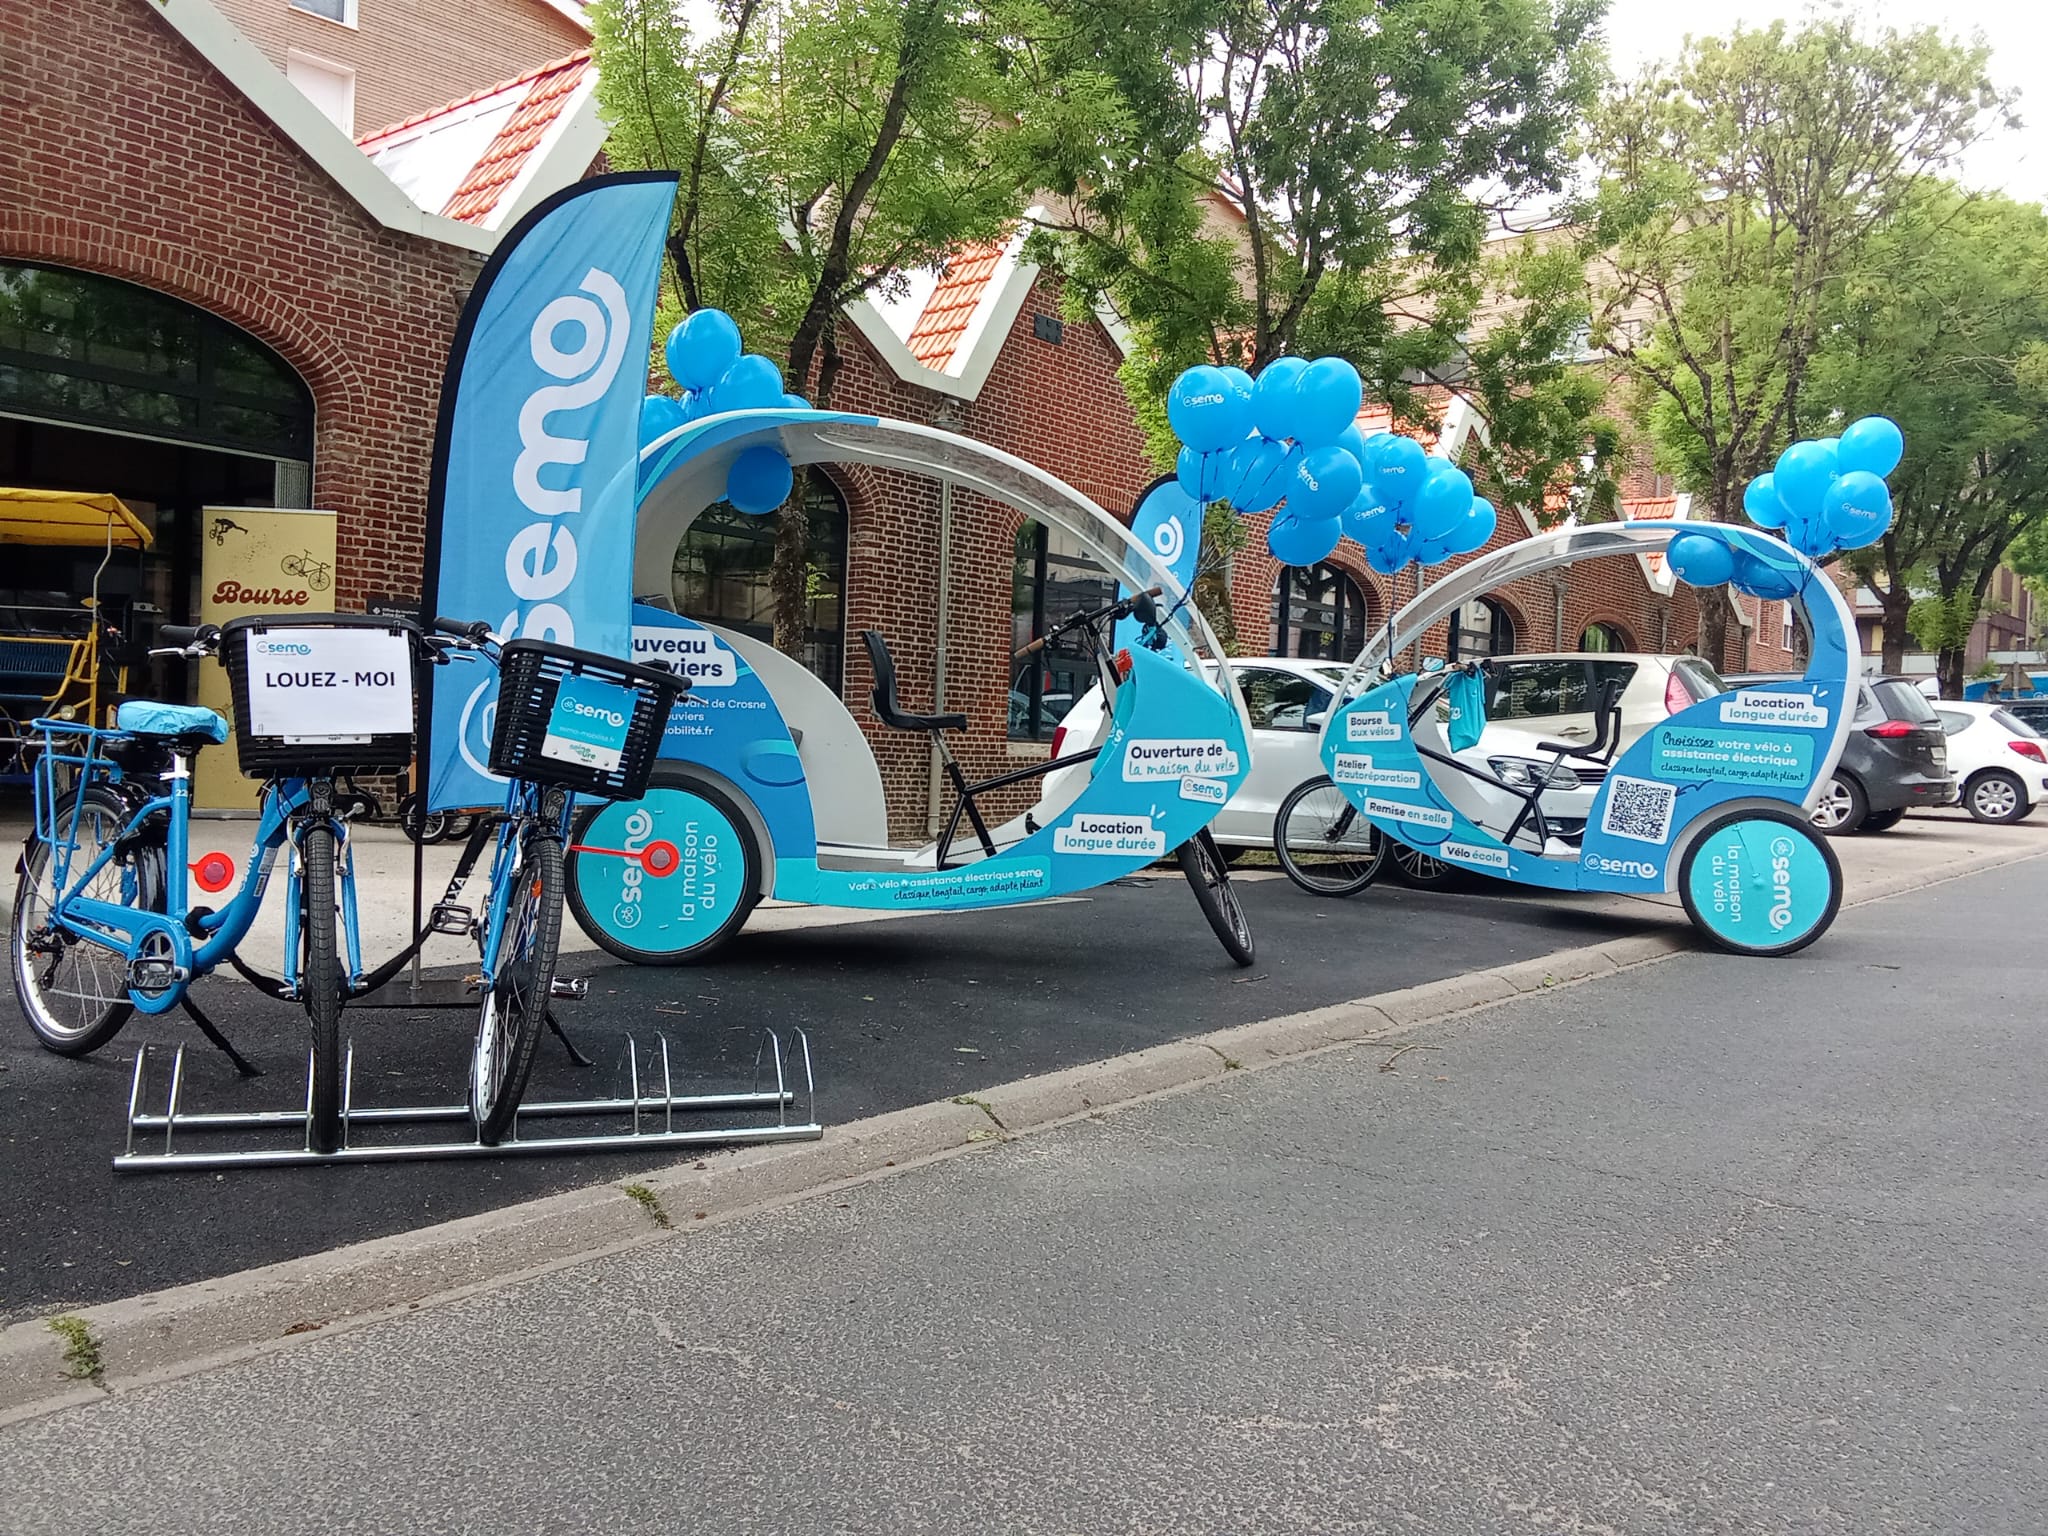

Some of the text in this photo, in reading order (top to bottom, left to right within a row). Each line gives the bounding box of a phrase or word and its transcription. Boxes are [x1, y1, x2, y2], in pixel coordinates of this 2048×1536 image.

[212, 581, 310, 606] Bourse
[268, 643, 312, 656] semo
[266, 672, 337, 688] LOUEZ
[355, 671, 395, 687] MOI
[711, 699, 726, 709] de
[728, 699, 767, 710] Crosne
[1744, 697, 1805, 710] Location
[574, 703, 625, 728] semo
[1350, 716, 1383, 727] Bourse
[1729, 708, 1819, 723] longue durée
[1350, 726, 1395, 737] aux vélos
[1662, 731, 1793, 753] Choisissez votre vélo à
[1131, 744, 1223, 759] Ouverture de
[1661, 749, 1798, 767] assistance électrique
[1128, 761, 1142, 776] la
[1147, 762, 1191, 775] maison
[1194, 760, 1213, 773] du
[1337, 759, 1368, 770] Atelier
[1336, 770, 1417, 785] d'autoréparation
[1192, 782, 1223, 799] semo
[1369, 801, 1448, 825] Remise en selle
[1080, 821, 1143, 835] Location
[1064, 834, 1157, 850] longue durée
[1446, 845, 1503, 864] Vélo école
[677, 820, 699, 921] la maison
[698, 834, 718, 910] du vélo
[1600, 857, 1658, 879] semo
[879, 878, 900, 889] vélo
[910, 875, 963, 888] assistance
[964, 870, 1014, 884] électrique
[1015, 868, 1044, 879] semo
[1711, 855, 1729, 914] du vélo
[1727, 844, 1743, 924] la maison
[1768, 855, 1793, 931] semo
